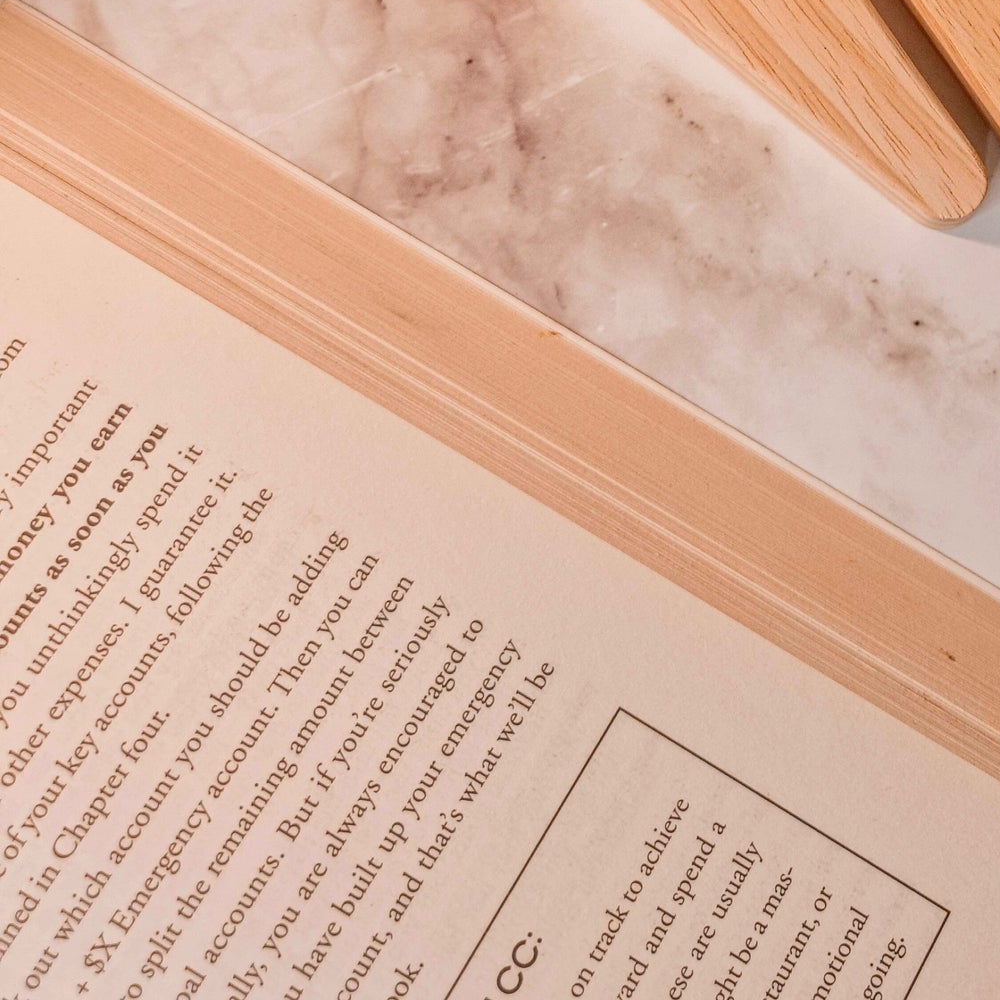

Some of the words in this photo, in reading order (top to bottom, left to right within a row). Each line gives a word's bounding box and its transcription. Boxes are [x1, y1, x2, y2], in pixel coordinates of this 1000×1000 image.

[0, 339, 27, 378] om
[5, 379, 98, 487] important
[46, 555, 69, 580] as
[68, 498, 115, 551] soon
[112, 468, 134, 493] as
[130, 424, 168, 470] you
[52, 457, 92, 505] you
[91, 404, 133, 451] earn
[1, 724, 50, 787] other
[49, 623, 129, 720] expenses.
[120, 597, 142, 614] I
[140, 495, 218, 601] guarantee
[209, 472, 237, 493] it.
[26, 532, 139, 675] unthinkingly
[136, 463, 188, 530] spend
[178, 445, 203, 465] it
[4, 824, 28, 860] of
[22, 775, 67, 838] your
[55, 731, 99, 776] key
[95, 632, 176, 732] accounts,
[166, 524, 253, 626] following
[241, 488, 273, 522] the
[25, 947, 59, 990] out
[54, 871, 112, 940] which
[109, 769, 180, 865] account
[175, 722, 214, 771] you
[209, 637, 270, 718] should
[258, 610, 290, 637] be
[288, 531, 349, 606] adding
[84, 932, 121, 974] $X
[108, 800, 211, 935] Emergency
[208, 707, 279, 799] account.
[266, 641, 322, 696] Then
[316, 595, 352, 640] you
[349, 555, 379, 591] can
[29, 866, 61, 892] in
[52, 764, 129, 859] Chapter
[120, 711, 170, 763] four.
[141, 923, 182, 979] split
[176, 880, 211, 919] the
[208, 757, 298, 878] remaining
[290, 666, 354, 755] amount
[342, 577, 414, 663] between
[204, 854, 285, 964] accounts.
[276, 795, 319, 842] But
[310, 762, 336, 792] if
[332, 697, 383, 771] you're
[382, 595, 450, 692] seriously
[262, 907, 301, 959] you
[299, 863, 327, 901] are
[325, 780, 381, 858] always
[379, 644, 467, 774] encouraged
[462, 620, 483, 642] to
[292, 922, 342, 981] have
[331, 857, 383, 917] built
[378, 822, 409, 852] up
[402, 760, 443, 821] your
[441, 639, 521, 757] emergency
[389, 872, 424, 923] and
[417, 809, 463, 870] that's
[459, 747, 502, 802] what
[497, 690, 536, 741] we'll
[524, 663, 554, 690] be
[496, 932, 542, 995] CC:
[571, 968, 595, 998] on
[589, 905, 630, 962] track
[623, 880, 643, 903] to
[640, 799, 689, 876] achieve
[646, 906, 676, 954] and
[672, 836, 716, 905] spend
[712, 822, 726, 835] a
[691, 926, 716, 961] are
[712, 841, 763, 919] usually
[729, 937, 758, 965] be
[754, 922, 768, 935] a
[762, 867, 793, 919] mas-
[814, 886, 832, 912] or
[863, 938, 906, 1000] going.
